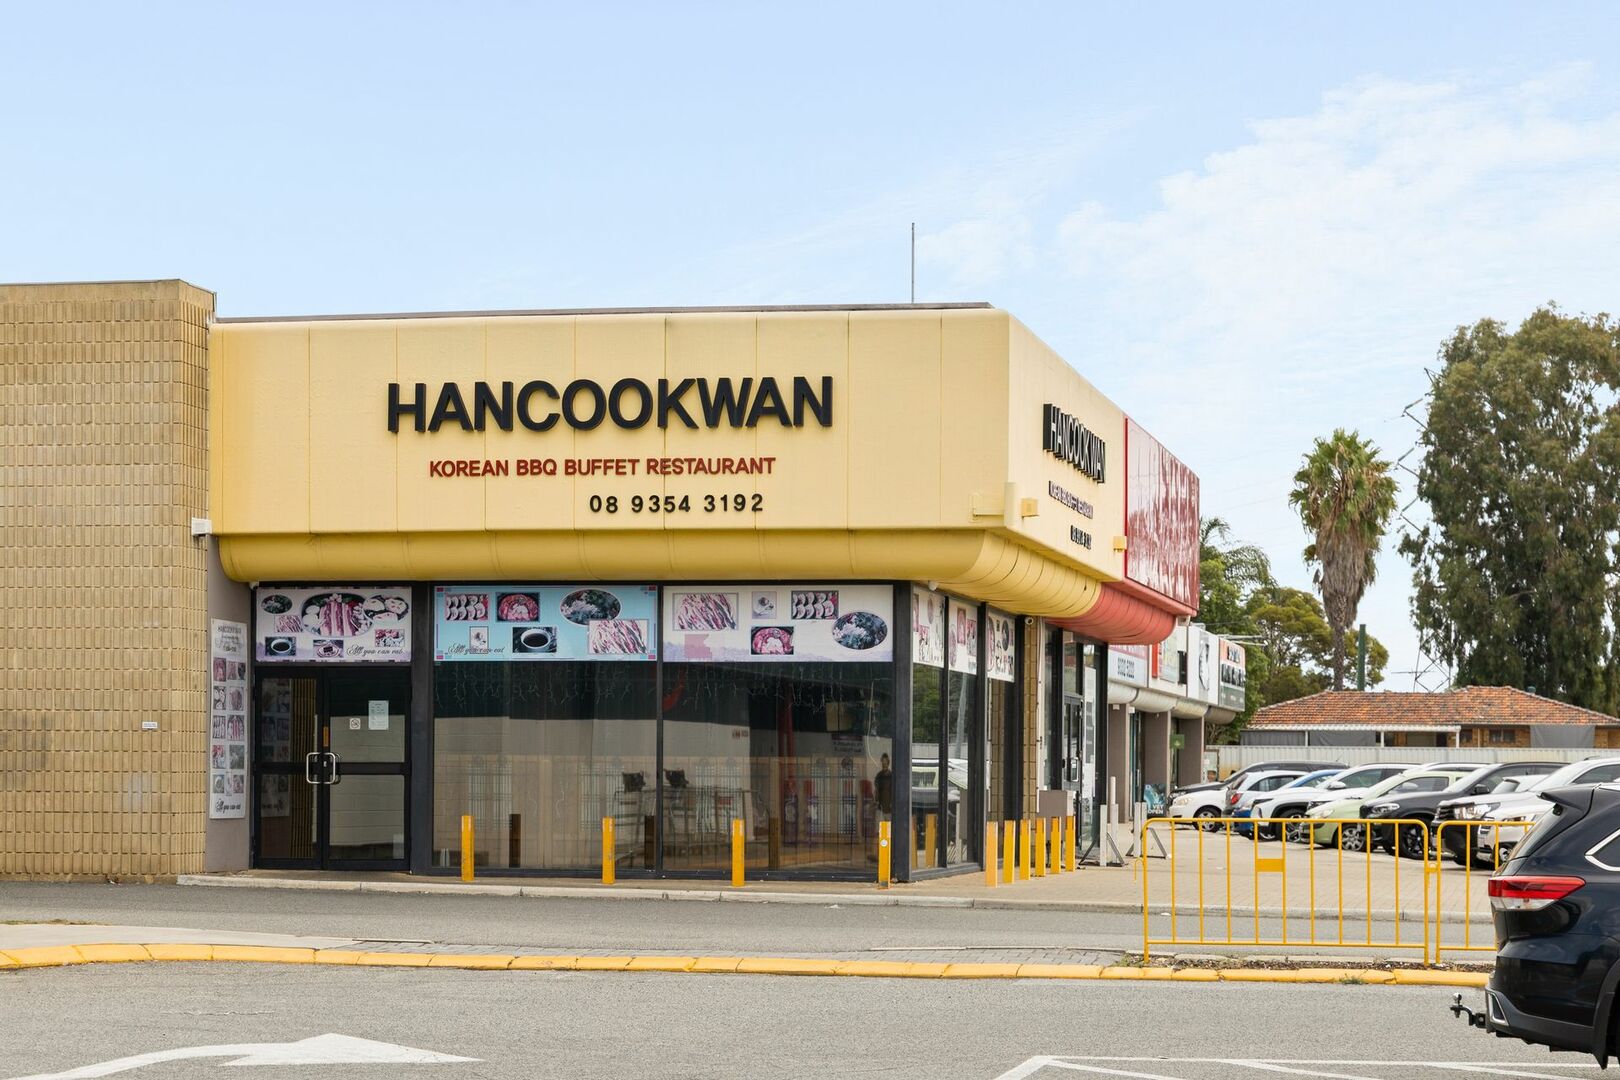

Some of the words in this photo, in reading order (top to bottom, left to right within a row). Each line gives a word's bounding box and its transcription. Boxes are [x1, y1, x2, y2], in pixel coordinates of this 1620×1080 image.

[387, 375, 833, 434] HANCOOKWAN
[1043, 404, 1105, 484] HANCOOKWAN
[430, 460, 508, 477] KOREAN
[517, 459, 557, 477] BBQ
[565, 459, 638, 476] BUFFET
[647, 457, 776, 476] RESTAURANT
[590, 494, 619, 514] 08
[631, 494, 690, 514] 9354
[704, 493, 764, 513] 3192
